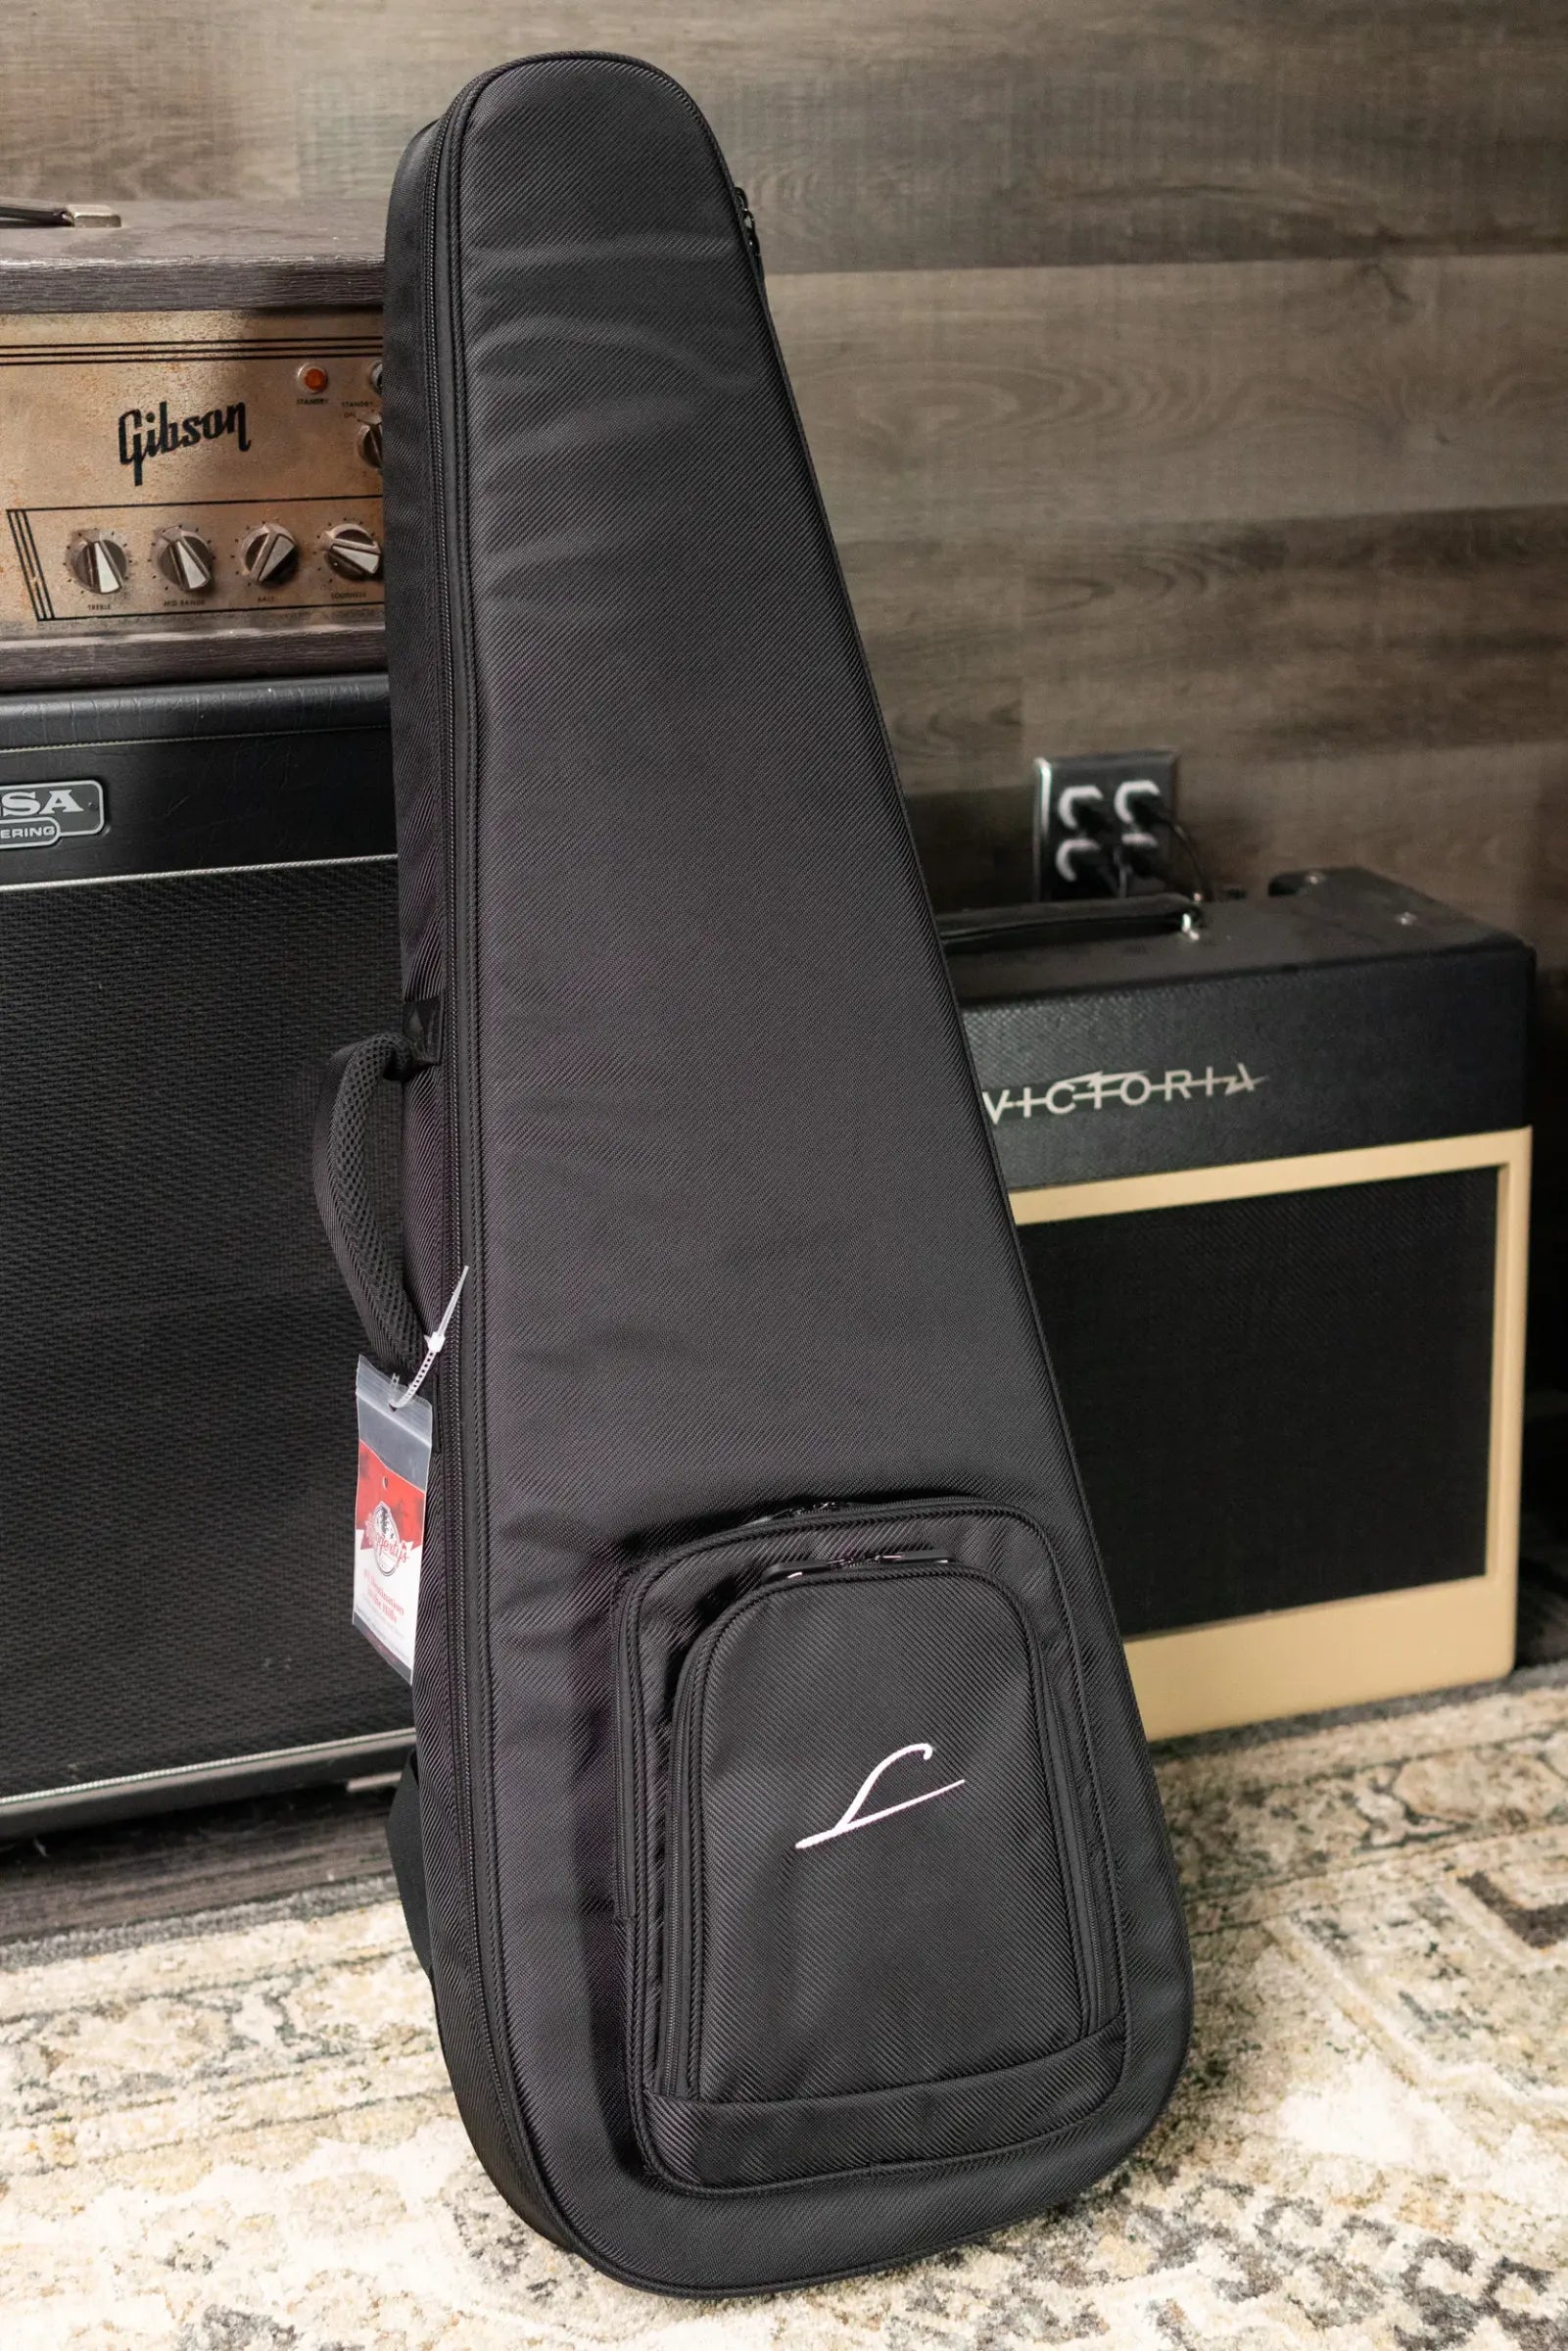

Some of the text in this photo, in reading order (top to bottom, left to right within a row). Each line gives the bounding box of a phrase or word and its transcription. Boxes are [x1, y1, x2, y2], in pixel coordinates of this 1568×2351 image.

[119, 402, 251, 486] Gibson
[0, 789, 84, 817] SA
[981, 1063, 1266, 1125] VICTORIA
